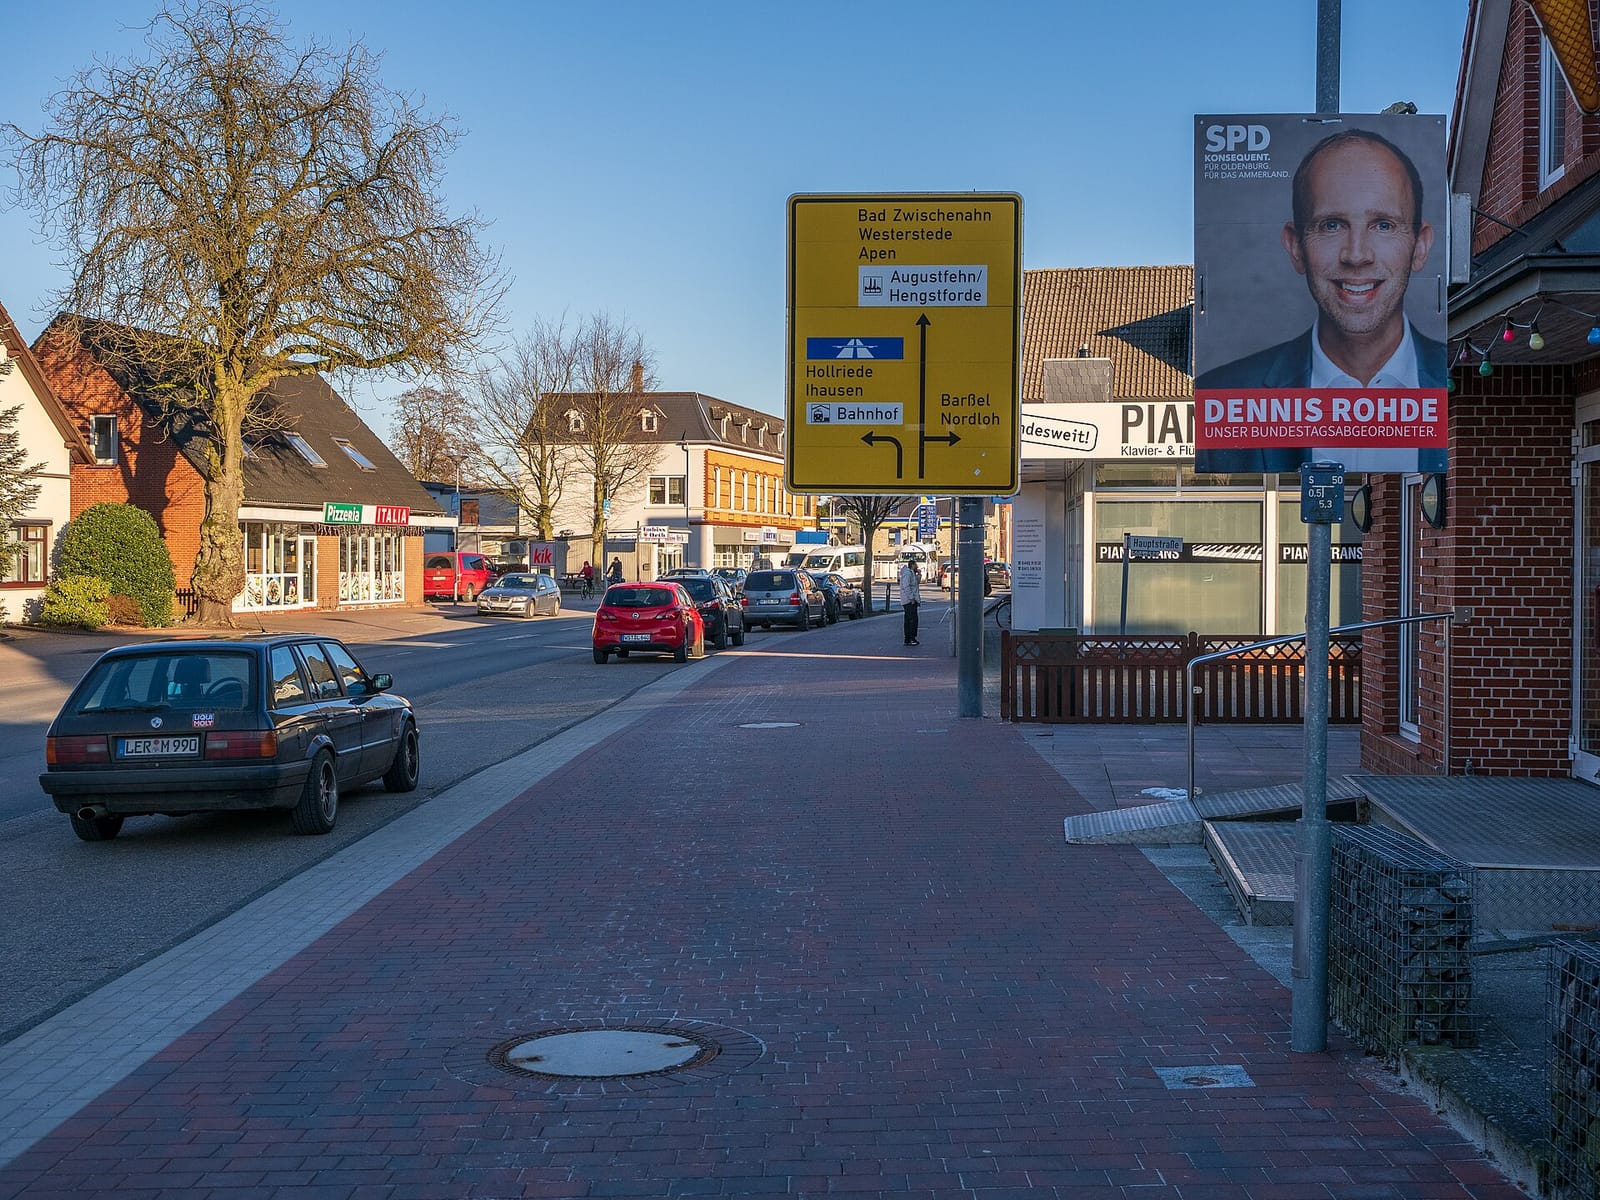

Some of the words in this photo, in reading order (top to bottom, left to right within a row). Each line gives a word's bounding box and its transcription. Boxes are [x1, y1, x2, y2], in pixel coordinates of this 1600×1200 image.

[1205, 125, 1271, 153] SPD
[1204, 153, 1271, 162] KONSEQUENT.
[1204, 162, 1219, 171] FÜR
[1221, 162, 1271, 170] OLDENBURG.
[1204, 171, 1219, 179] FÜR
[1221, 171, 1237, 179] DAS
[1238, 170, 1291, 178] AMMERLAND.
[858, 208, 886, 222] Bad
[893, 208, 992, 222] Zwischenahn
[859, 227, 953, 241] Westerstede
[858, 246, 897, 263] Apen
[890, 269, 983, 286] Augustfehn/
[890, 288, 982, 305] Hengstforde
[806, 365, 873, 378] Hollriede
[806, 383, 863, 397] Ihausen
[941, 393, 991, 407] Barßel
[837, 407, 899, 420] Bahnhof
[1204, 397, 1323, 423] DENNIS
[1332, 397, 1438, 423] ROHDE
[941, 412, 1000, 425] Nordloh
[1204, 425, 1248, 438] UNSER
[1251, 425, 1438, 438] BUNDESTAGSABGEORDNETER.
[1121, 445, 1163, 456] Klavier-
[1166, 445, 1175, 456] &
[1308, 475, 1315, 484] S
[1331, 475, 1343, 485] 50
[327, 505, 360, 522] Pizzeria
[376, 507, 408, 523] ITALIA
[1133, 538, 1180, 549] Hauptstraße
[533, 546, 552, 564] kik
[193, 713, 214, 721] LIQUI
[193, 720, 214, 728] MOLY
[125, 740, 151, 754] LER
[161, 739, 171, 752] M
[173, 738, 197, 752] 990
